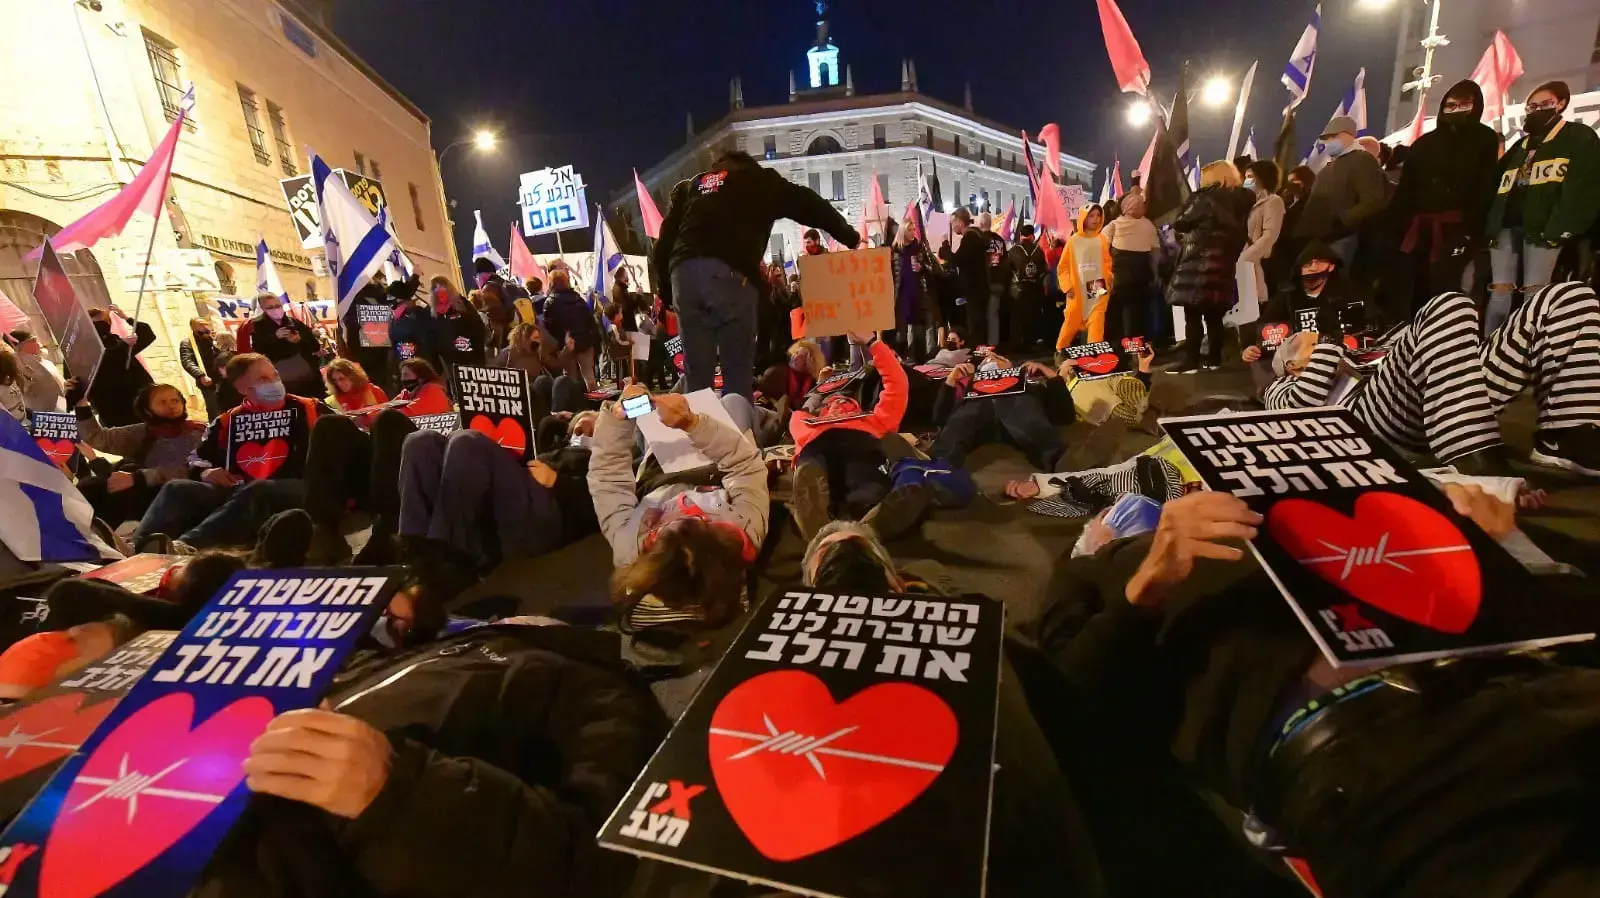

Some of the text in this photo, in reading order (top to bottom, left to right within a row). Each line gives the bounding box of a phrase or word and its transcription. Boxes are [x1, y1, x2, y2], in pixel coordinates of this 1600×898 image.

[550, 168, 571, 185] אל
[523, 183, 575, 206] תגע לנו
[529, 205, 576, 230] בתם
[202, 234, 219, 248] THE
[222, 238, 253, 253] UNITED
[458, 366, 520, 384] המשטרה
[461, 381, 520, 398] שוברת לנו
[236, 409, 291, 423] המשטרה
[464, 395, 523, 416] את הלב
[34, 429, 78, 439] את הלב
[35, 421, 77, 430] שוברת לנו
[235, 426, 290, 442] את הלב
[236, 418, 290, 431] שוברת לנו
[1182, 417, 1356, 446] המשטרה
[1200, 437, 1372, 467] שוברת לנו
[1219, 458, 1408, 497] את הלב
[218, 577, 388, 606] המשטרה
[777, 592, 980, 624] המשטרה
[1318, 603, 1379, 632] אין
[194, 607, 362, 639] שוברת לנו
[768, 611, 976, 646] שוברת לנו
[1336, 628, 1394, 652] מצב
[152, 639, 335, 688] את הלב
[745, 632, 971, 683] את הלב
[60, 664, 146, 690] הלב
[636, 780, 708, 820] אין
[620, 809, 690, 848] מצב
